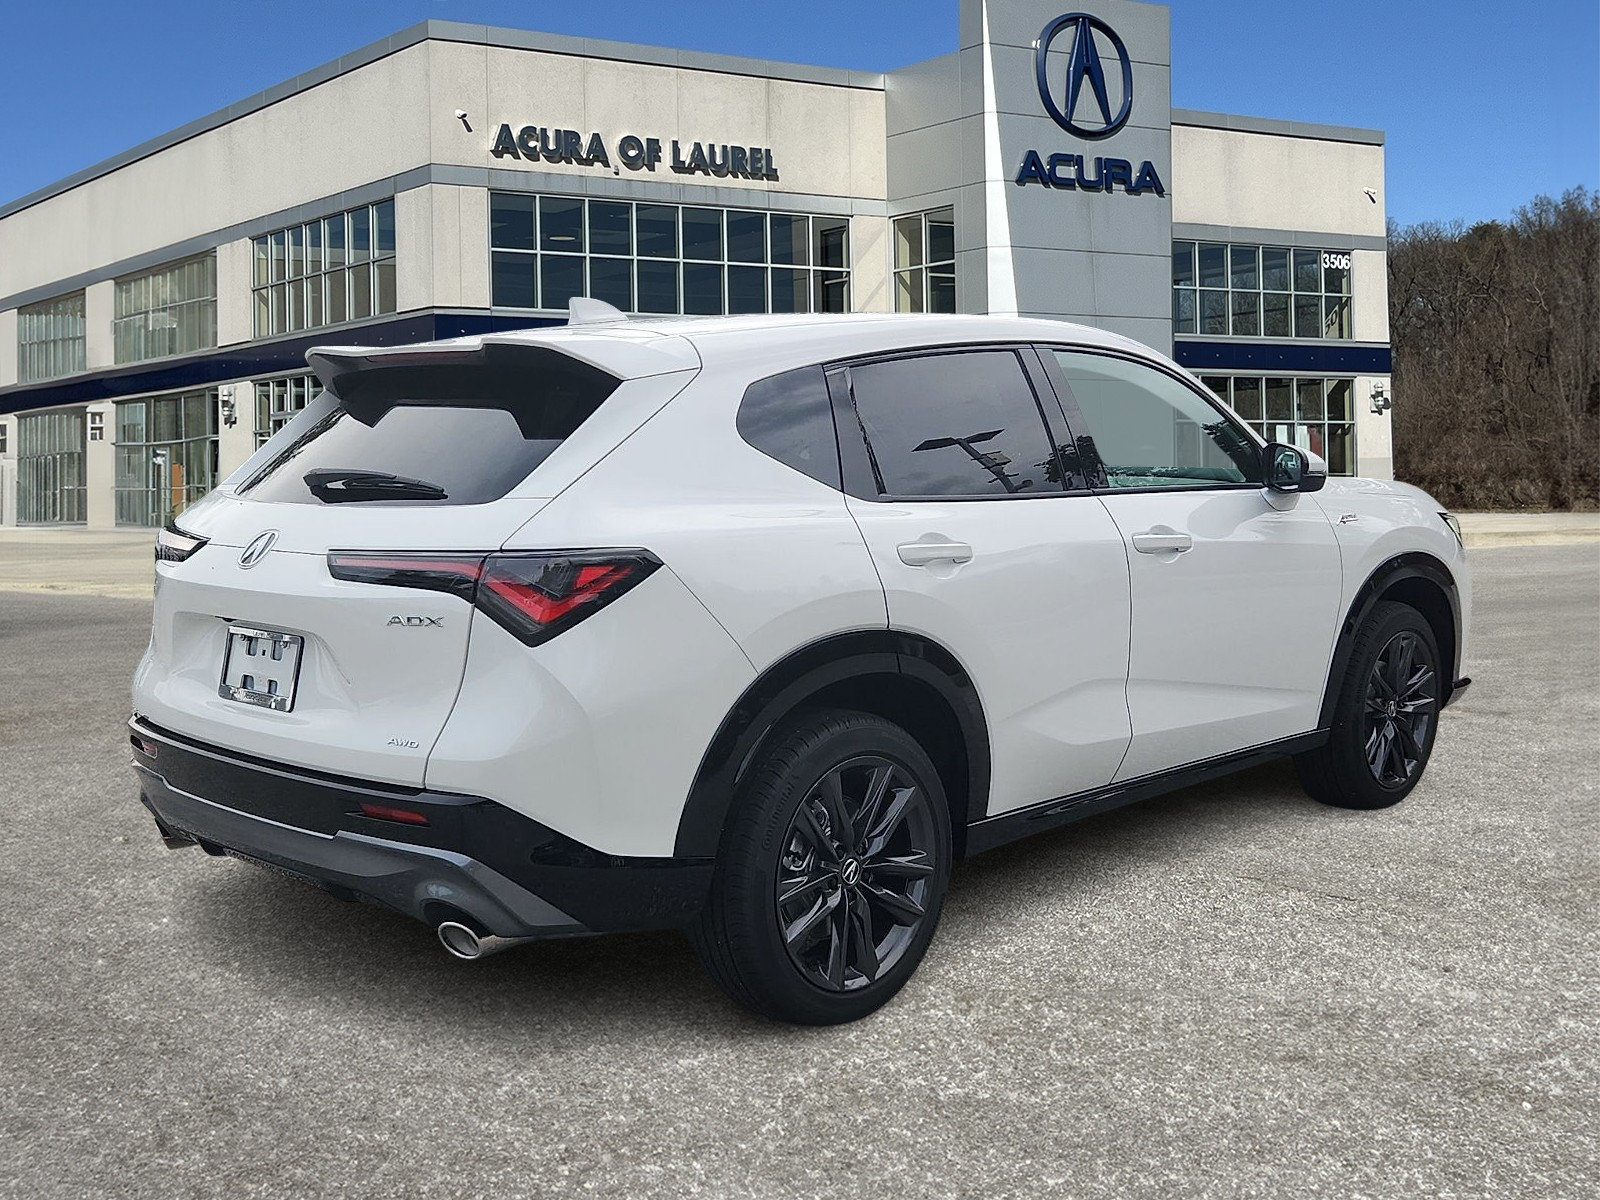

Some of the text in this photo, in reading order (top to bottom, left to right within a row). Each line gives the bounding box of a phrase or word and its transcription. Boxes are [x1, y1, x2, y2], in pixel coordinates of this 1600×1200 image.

[490, 123, 779, 182] ACURA OF LAUREL
[1016, 150, 1166, 198] ACURA
[1322, 253, 1351, 270] 3506
[386, 615, 444, 628] ADX
[387, 737, 420, 749] AWD
